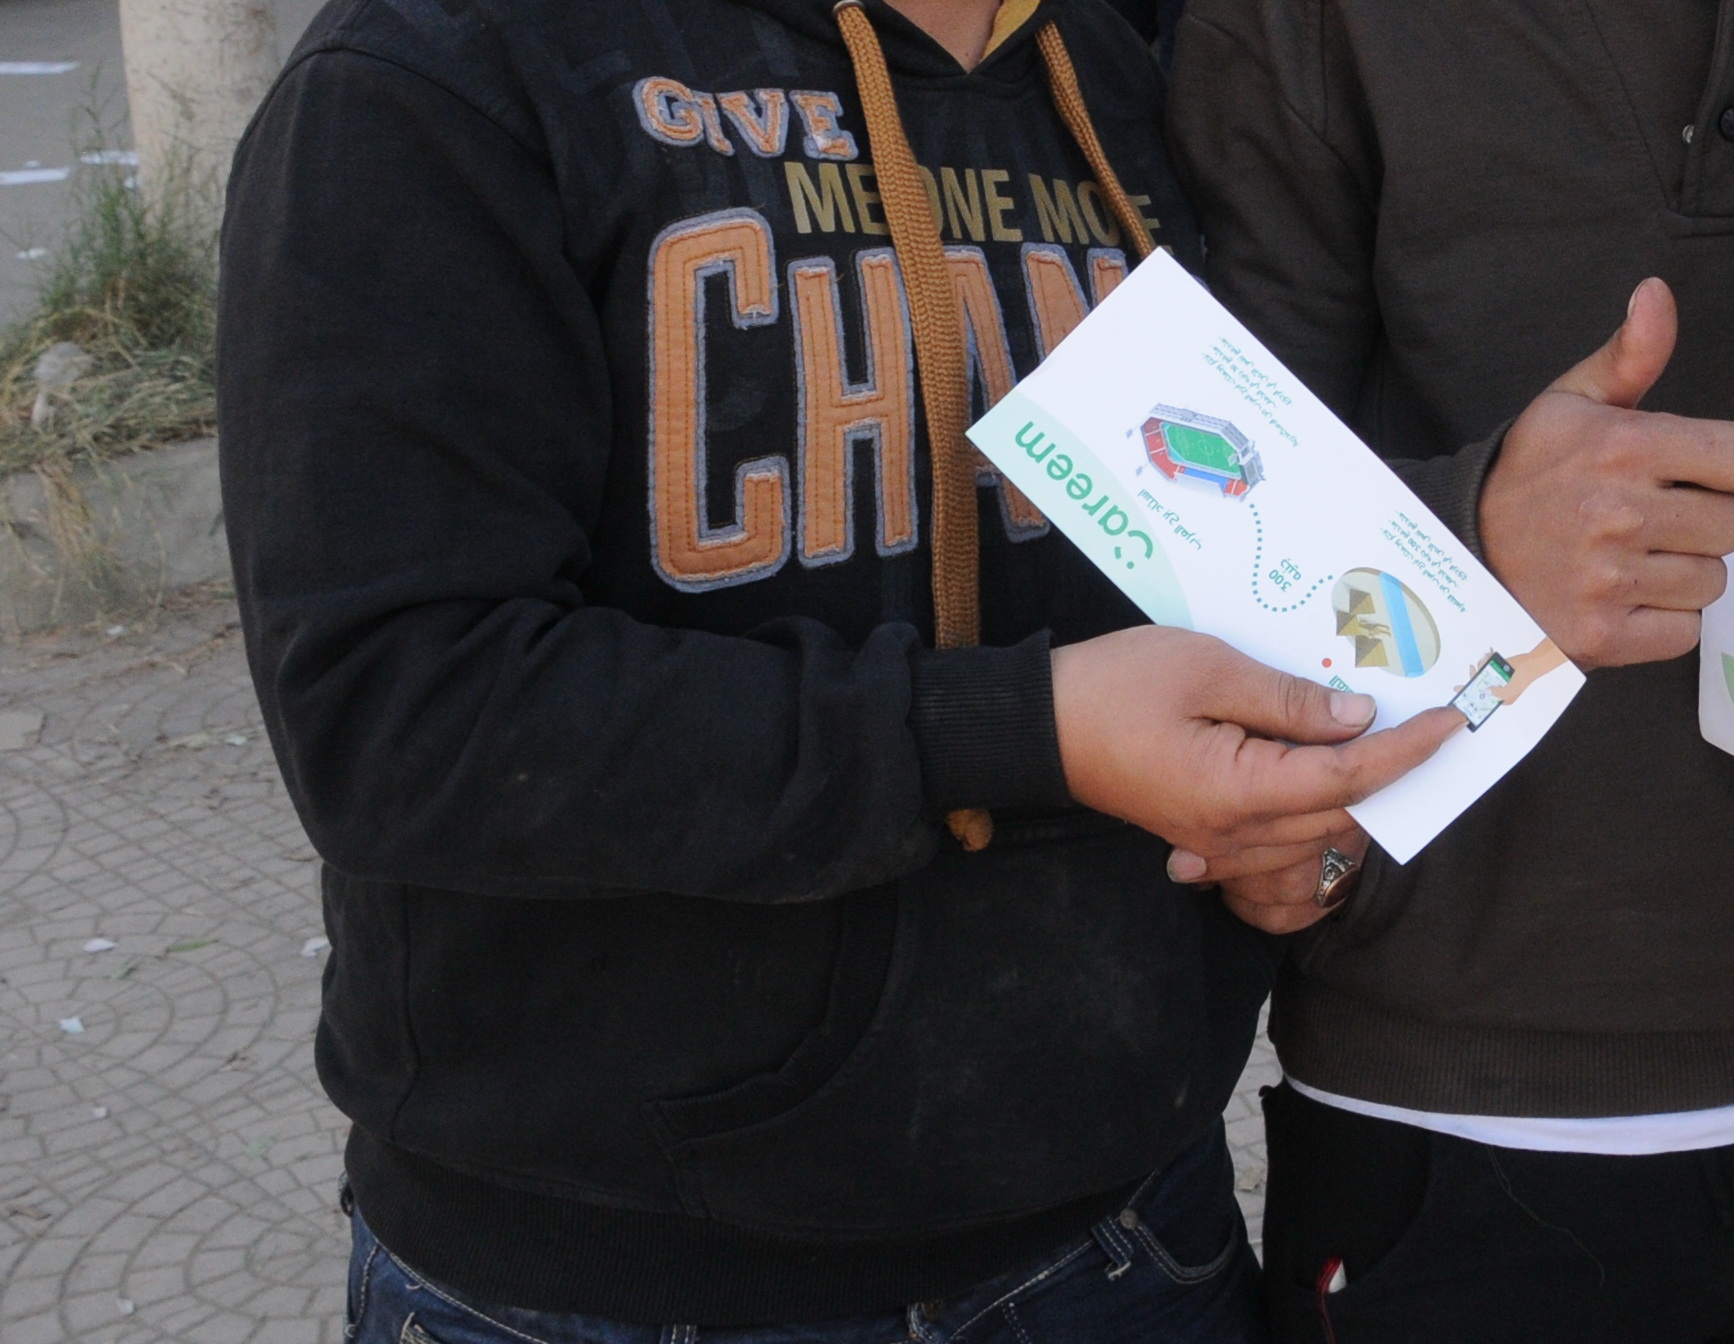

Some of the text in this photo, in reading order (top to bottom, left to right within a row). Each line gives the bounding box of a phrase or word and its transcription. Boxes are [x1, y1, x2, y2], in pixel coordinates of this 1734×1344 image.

[634, 76, 858, 160] GIVE
[784, 162, 890, 237] ME
[1016, 421, 1154, 570] Careem
[1137, 489, 1201, 550] استاد برج العرب
[1269, 569, 1292, 592] 300
[1280, 559, 1301, 580] جنيه
